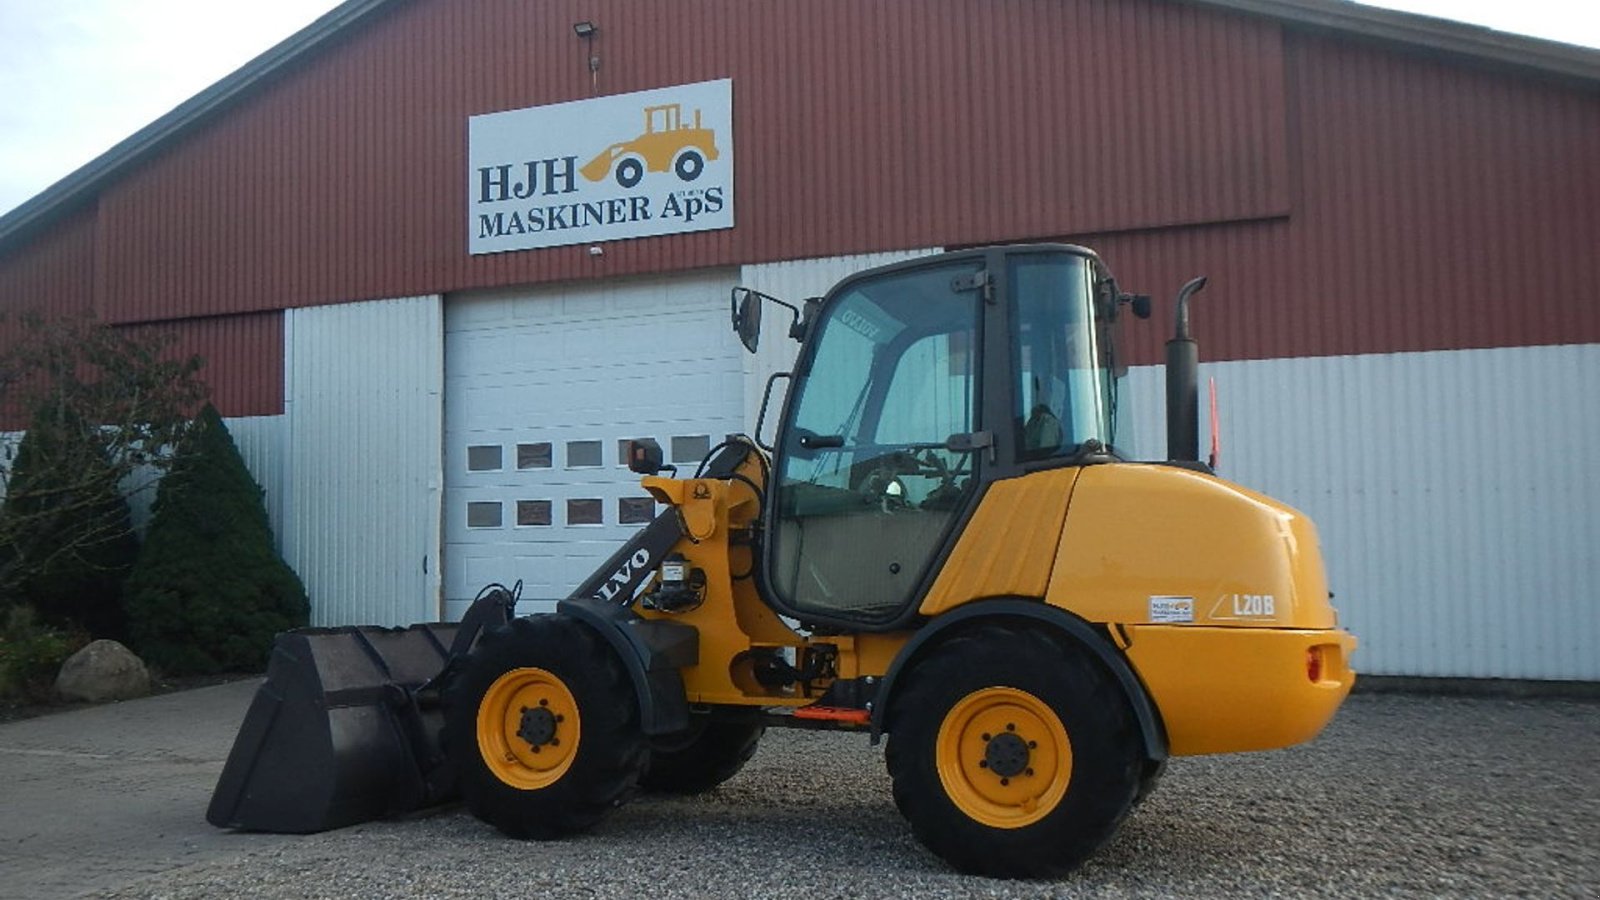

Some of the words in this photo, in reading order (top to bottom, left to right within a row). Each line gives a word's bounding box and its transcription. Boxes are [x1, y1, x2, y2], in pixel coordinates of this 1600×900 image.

[477, 156, 578, 204] HJH
[478, 196, 653, 238] MASKINER
[660, 187, 724, 222] ApS
[592, 547, 650, 601] LVO
[1233, 593, 1275, 616] L20B
